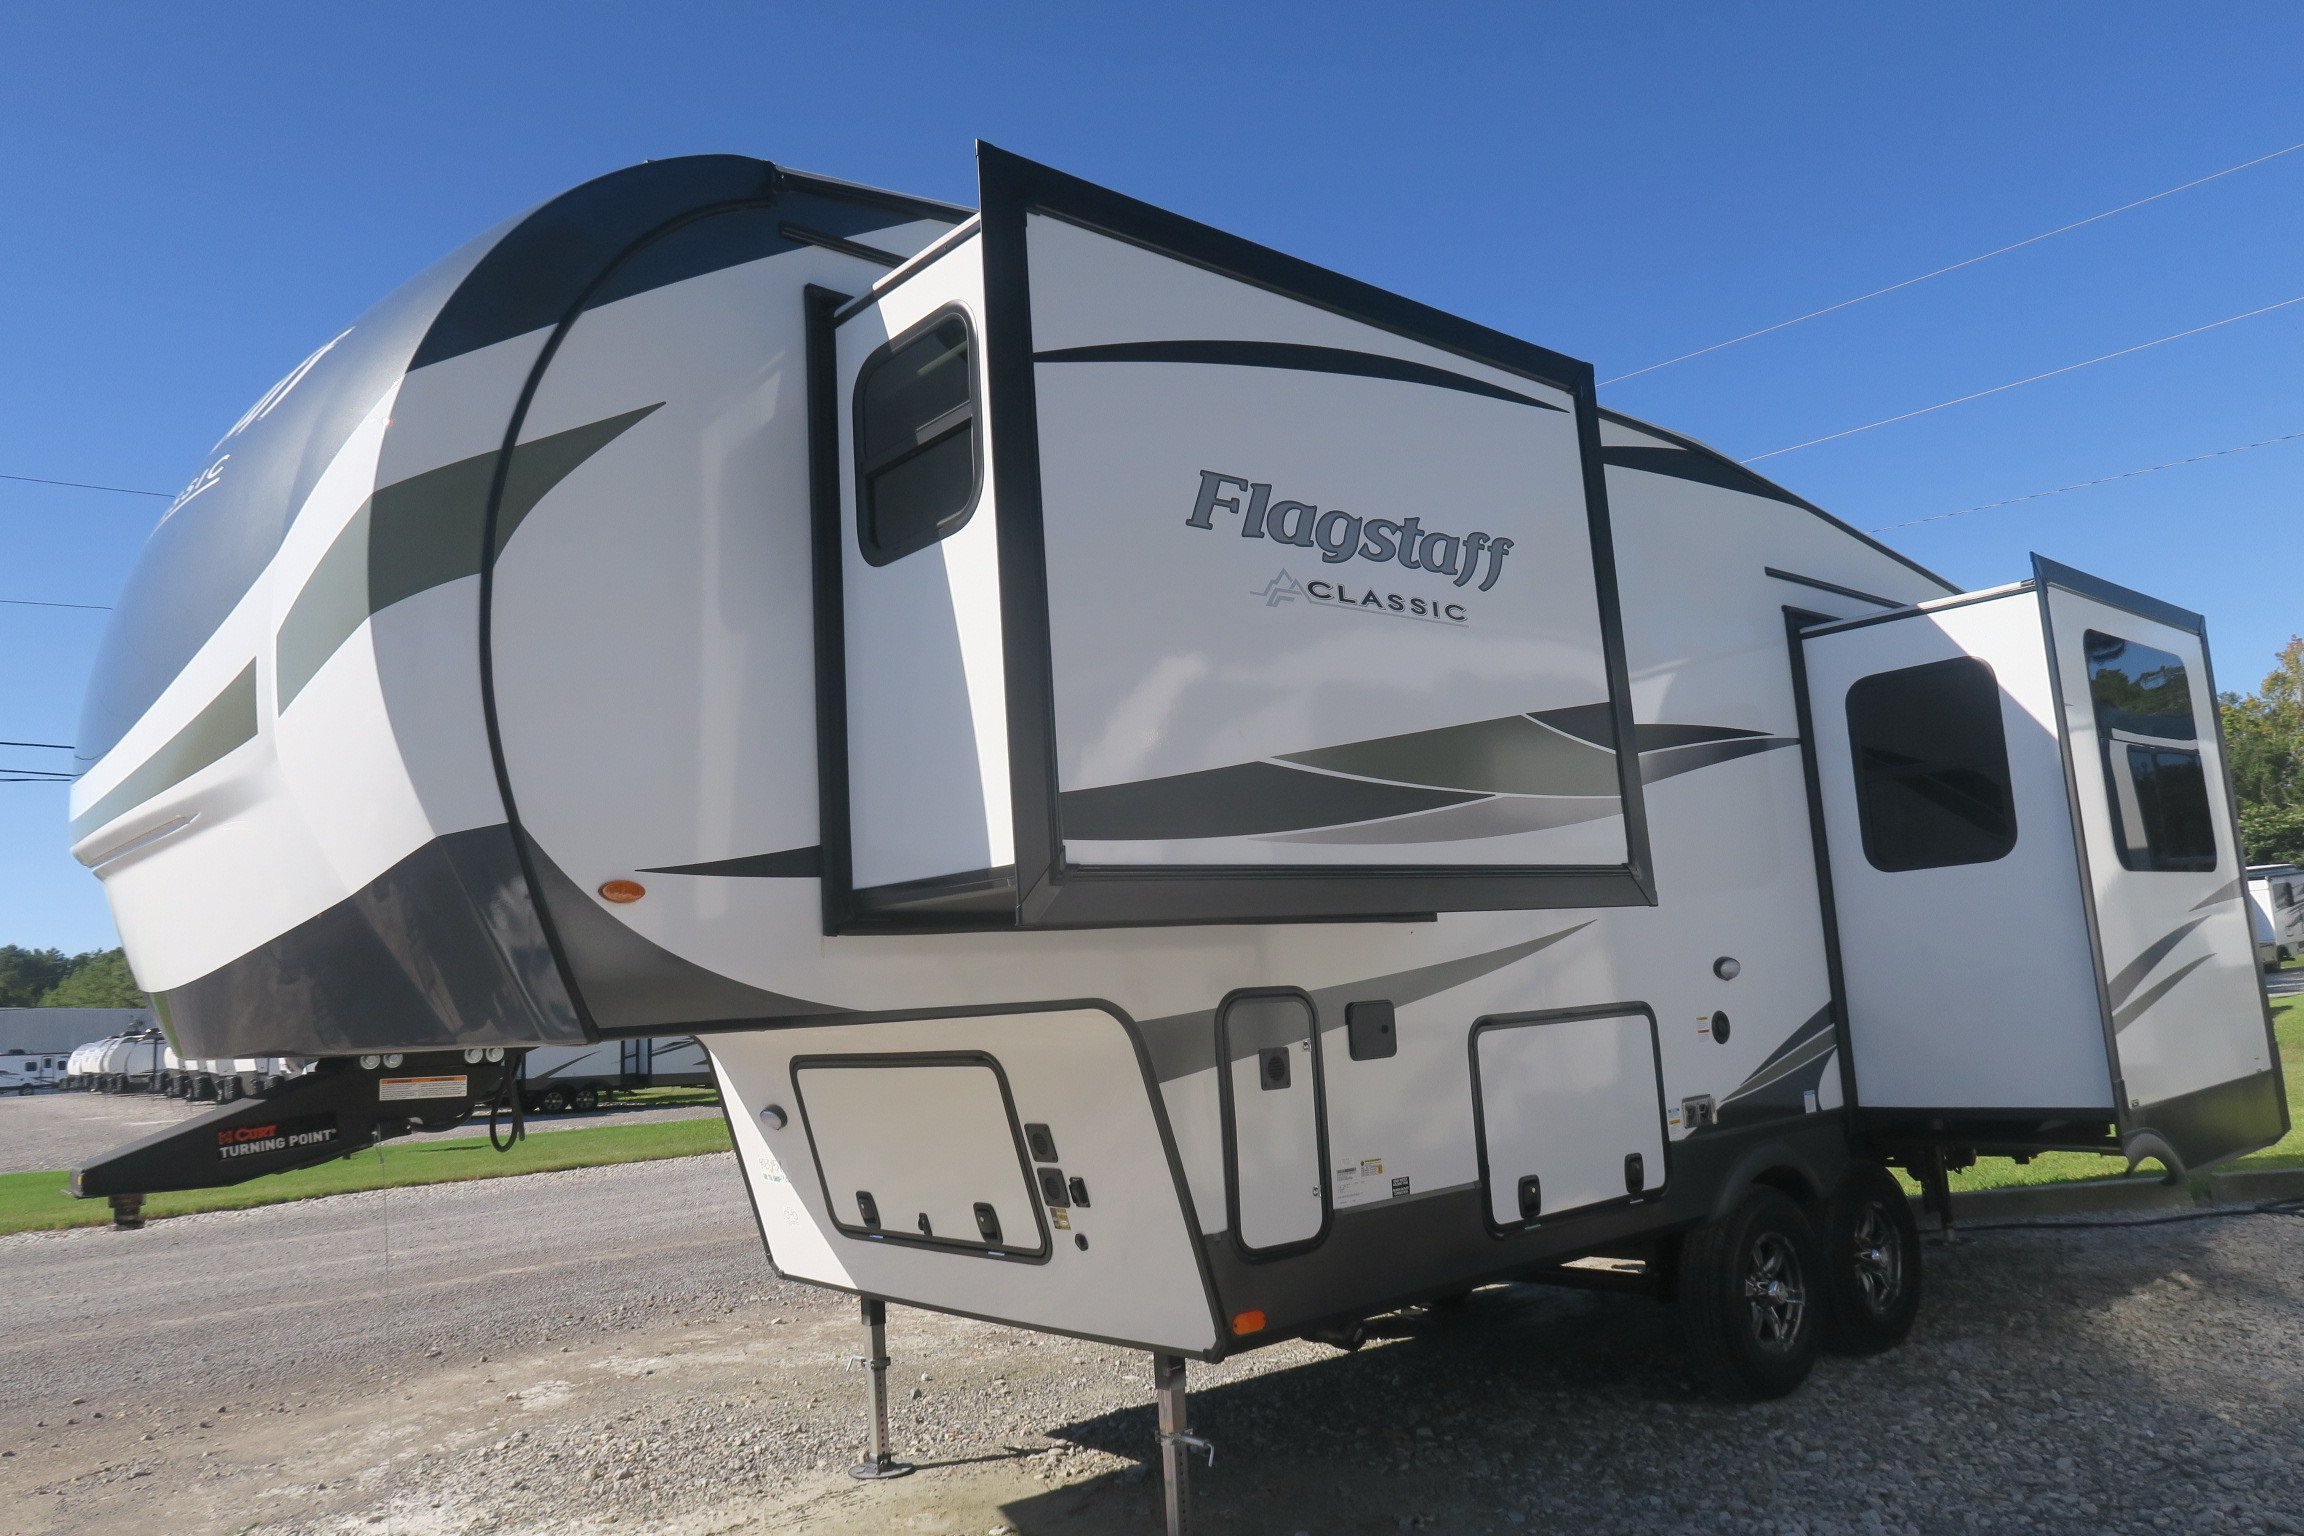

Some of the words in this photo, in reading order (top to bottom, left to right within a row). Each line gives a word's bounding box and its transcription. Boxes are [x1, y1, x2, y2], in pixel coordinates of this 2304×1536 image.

[1186, 469, 1515, 592] Flagstaff
[1307, 581, 1469, 622] CLASSIC
[219, 1137, 286, 1158] TURNING
